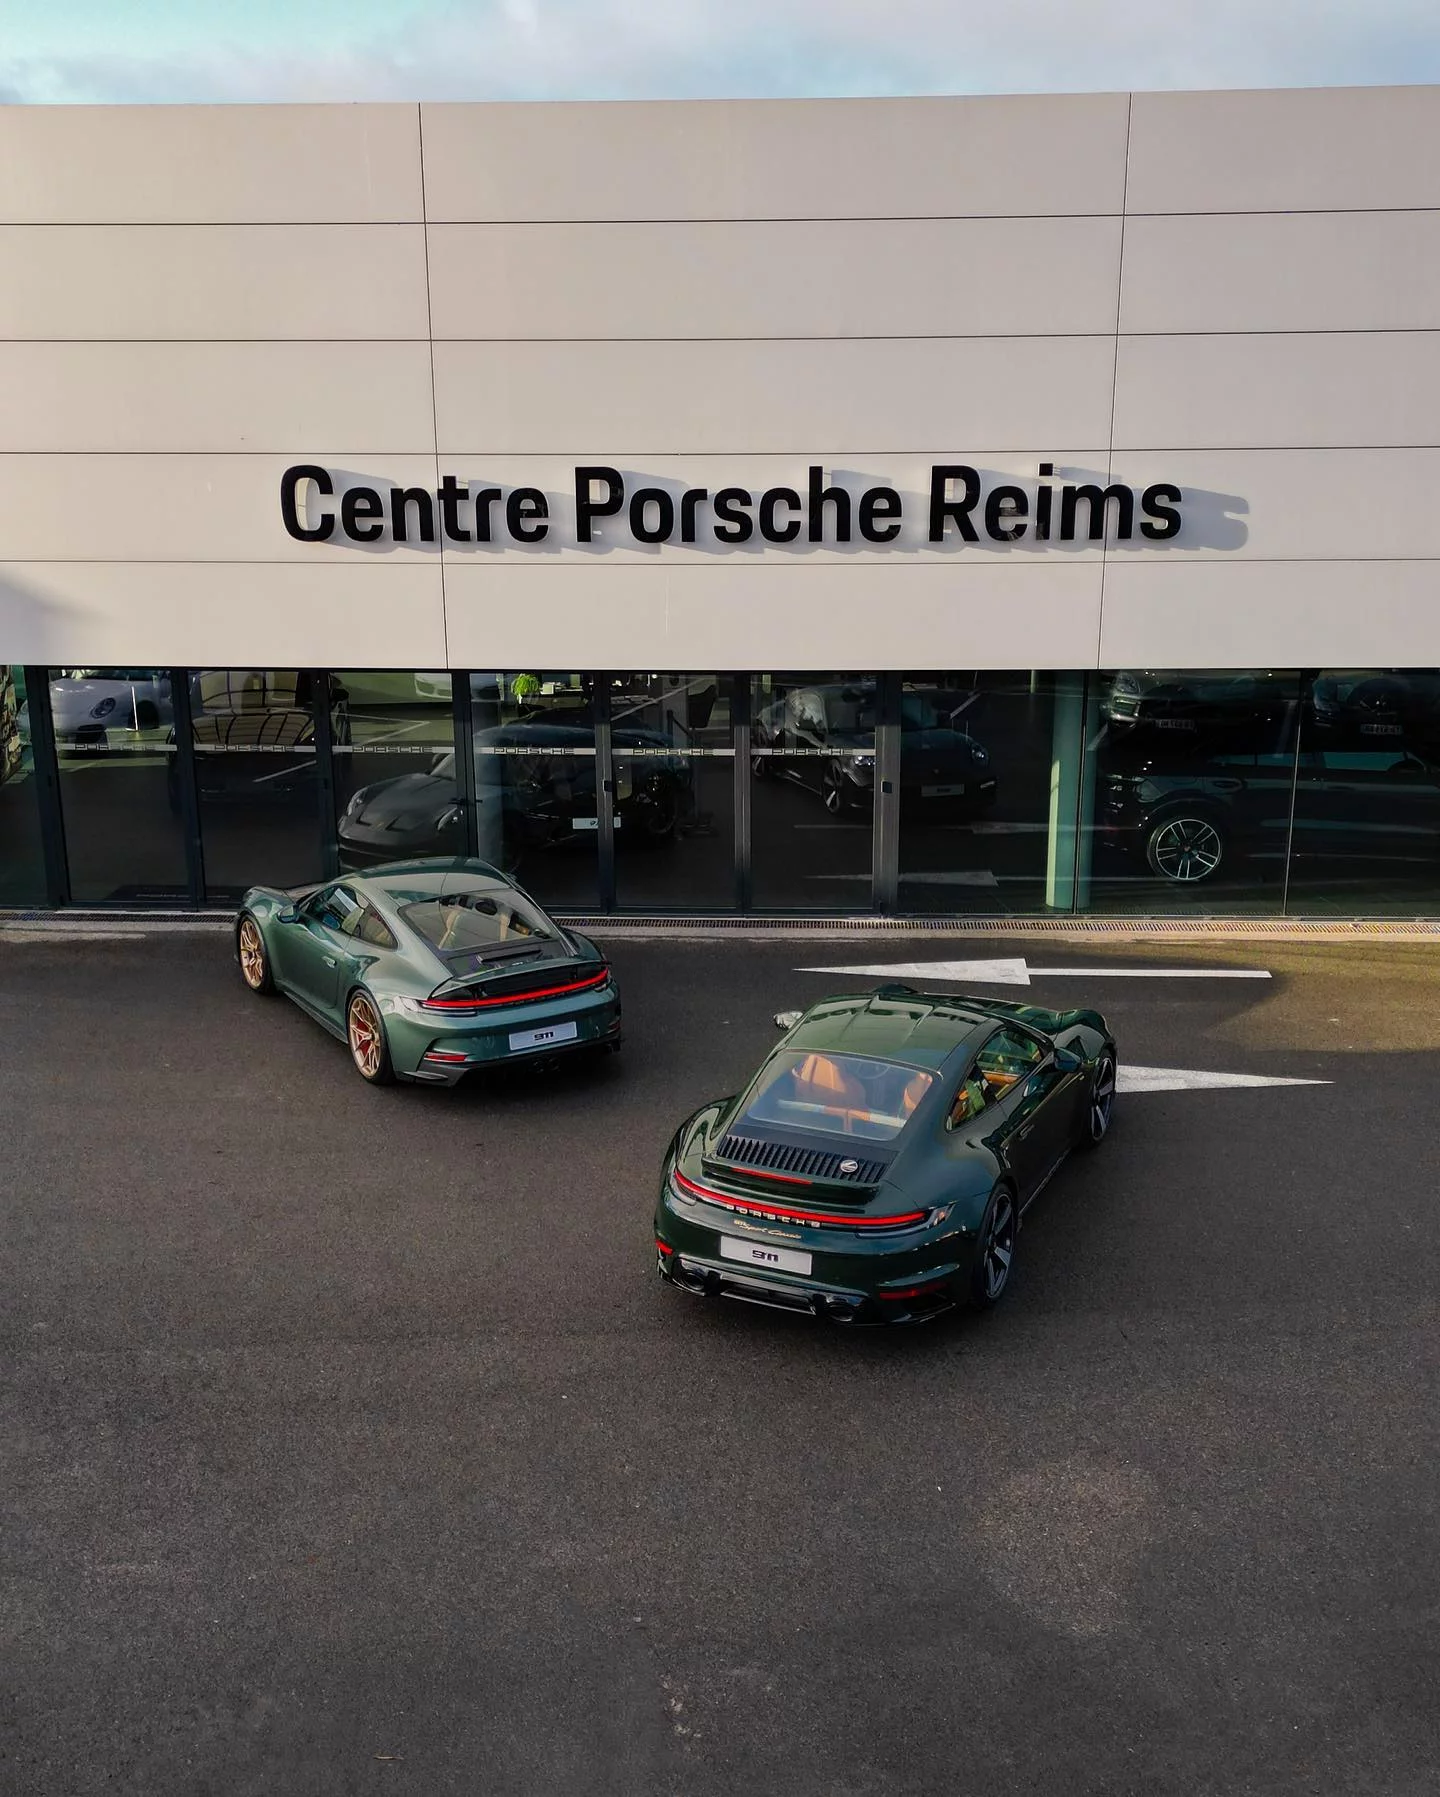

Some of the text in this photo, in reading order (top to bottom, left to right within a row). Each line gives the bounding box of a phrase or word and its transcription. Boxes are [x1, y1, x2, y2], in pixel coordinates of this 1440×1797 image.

[281, 462, 1182, 543] Centre Porsche Reims
[214, 744, 295, 752] PORSCHE
[493, 747, 574, 755] PORSCHE
[631, 748, 713, 756] PORSCHE
[771, 748, 853, 756] PORSCHE
[534, 1031, 554, 1041] 911
[726, 1204, 821, 1228] PORSCHE
[752, 1249, 779, 1262] 911
